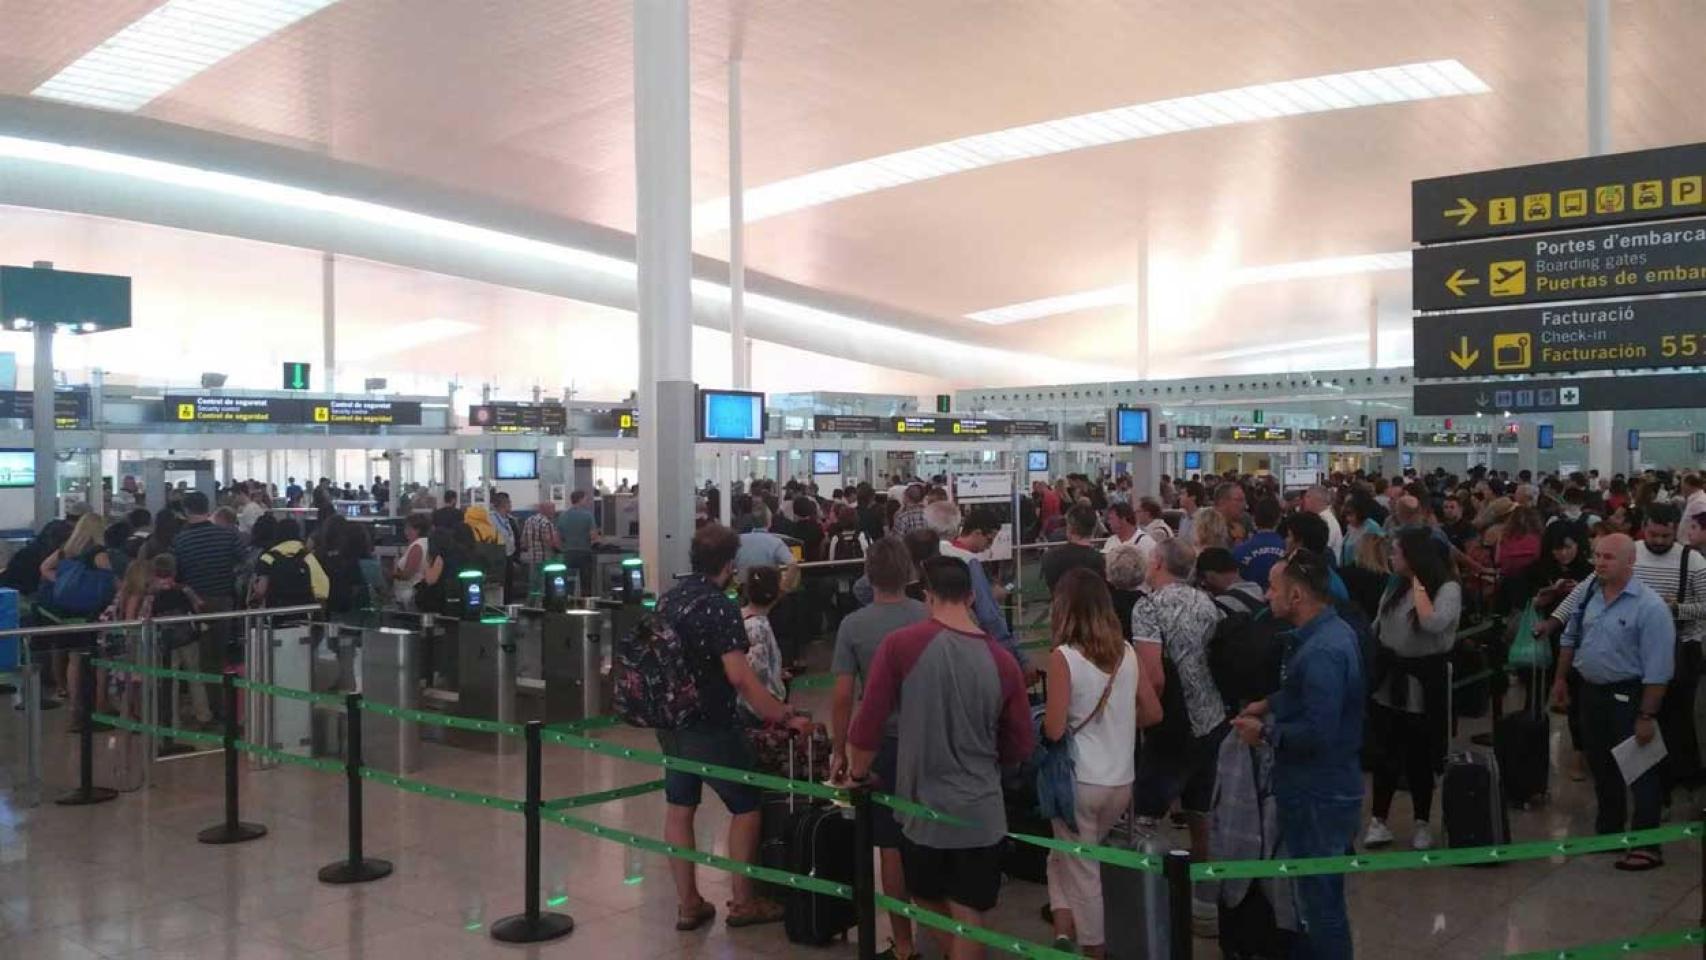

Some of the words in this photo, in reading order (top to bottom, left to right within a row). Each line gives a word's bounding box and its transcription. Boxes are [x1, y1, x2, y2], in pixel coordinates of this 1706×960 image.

[1679, 182, 1695, 201] P
[1536, 240, 1596, 256] Portes
[1603, 229, 1706, 250] d'embarca
[1536, 257, 1601, 273] Boarding
[1605, 252, 1648, 270] gates
[1536, 274, 1609, 292] Puertas
[1615, 270, 1638, 285] de
[1541, 304, 1635, 326] Facturació
[1541, 329, 1608, 344] Check-in
[1542, 343, 1646, 362] Facturación
[1661, 333, 1706, 357] 55
